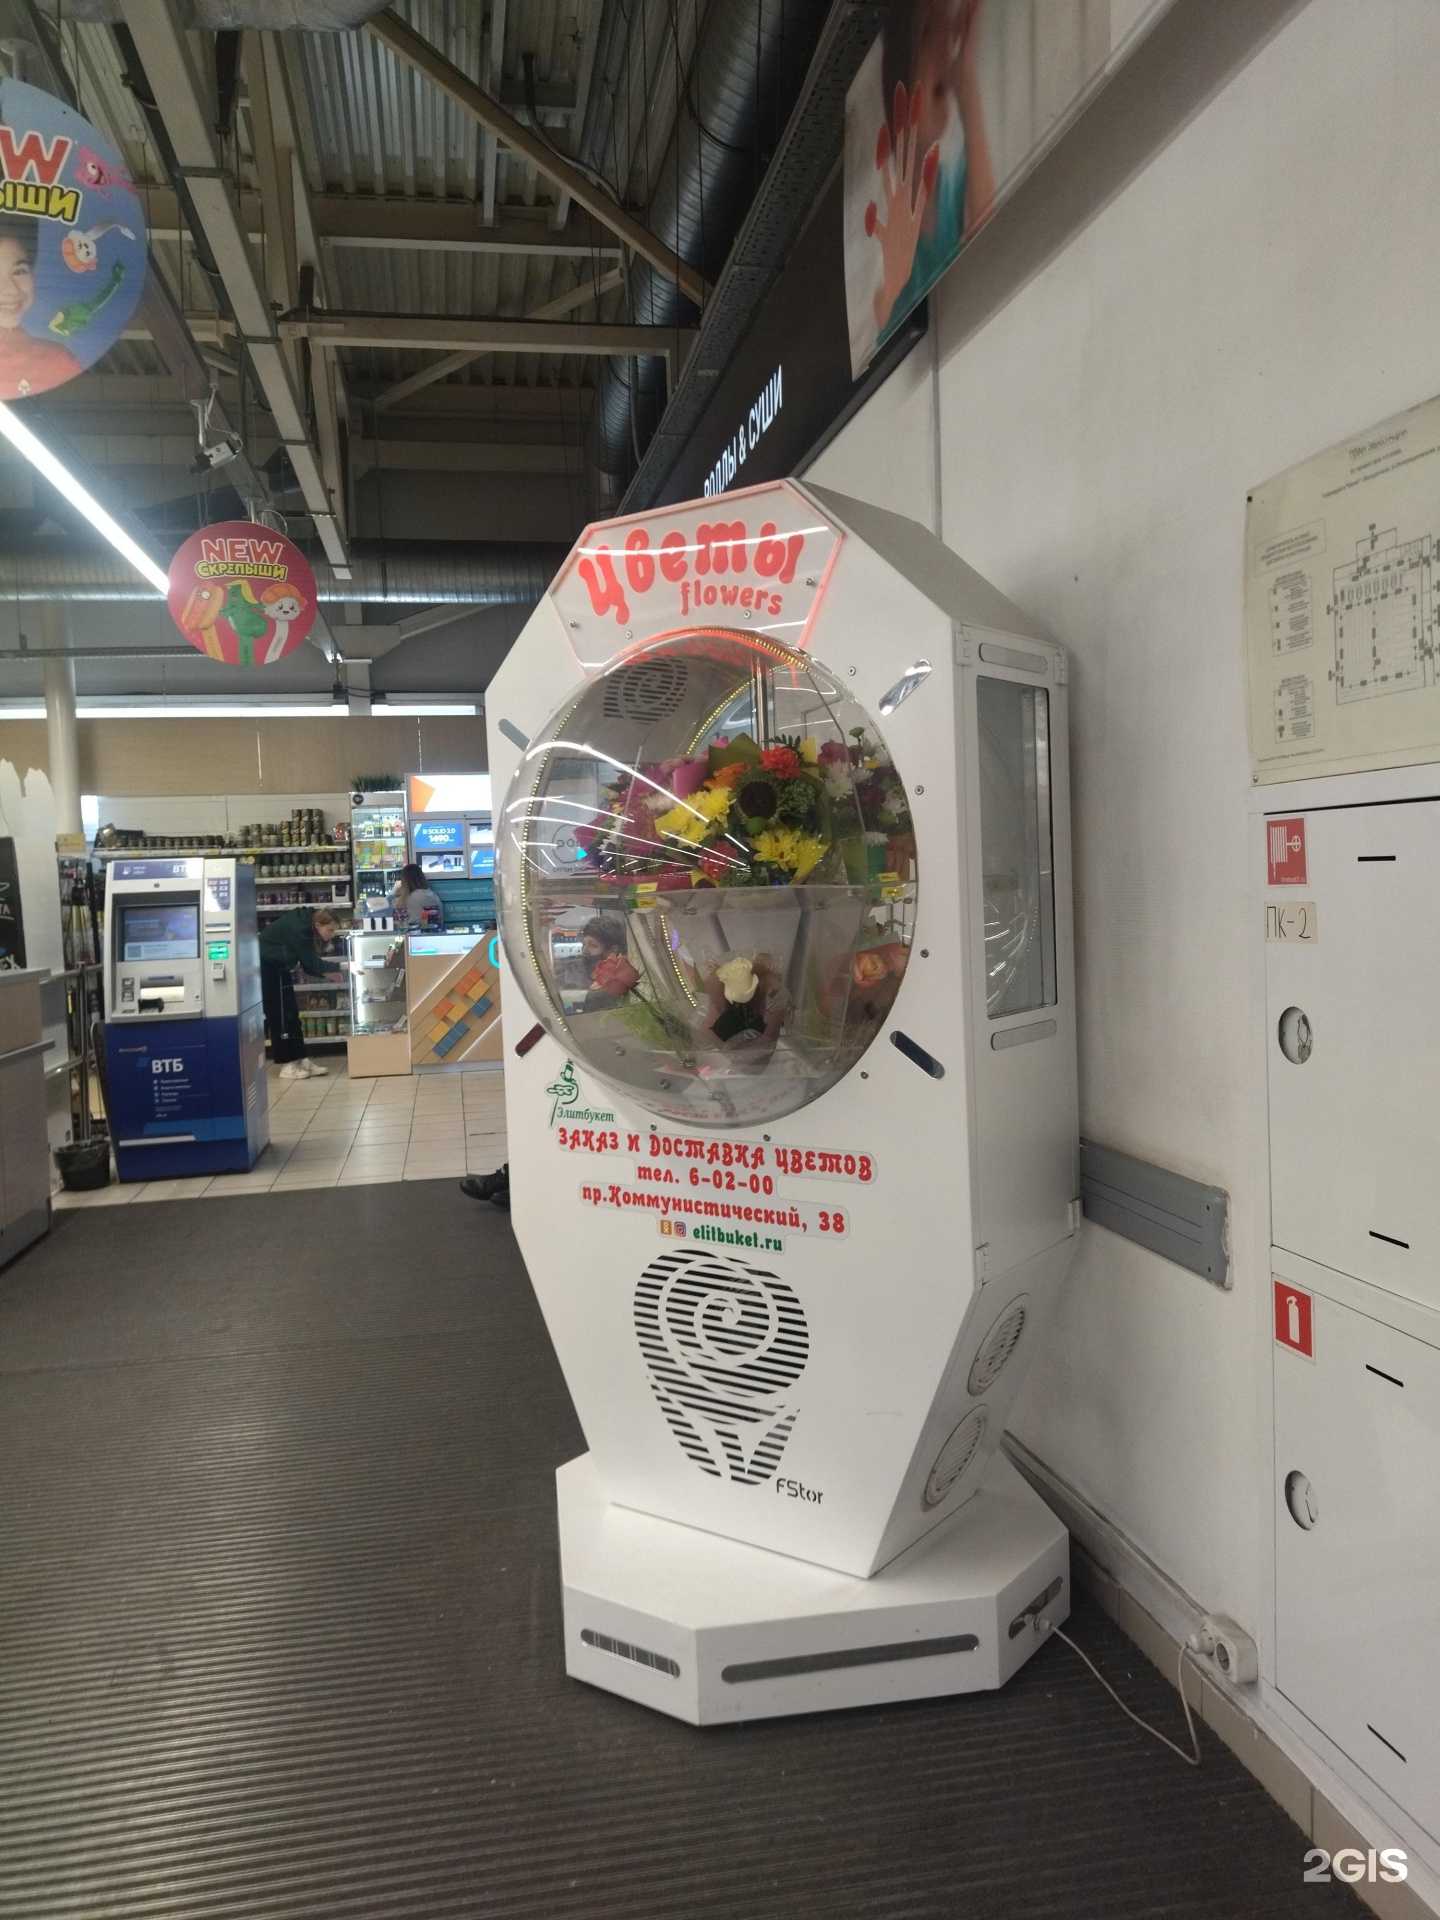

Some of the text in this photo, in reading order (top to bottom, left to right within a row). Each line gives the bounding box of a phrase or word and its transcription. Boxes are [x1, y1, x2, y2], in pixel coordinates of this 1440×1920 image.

[738, 423, 747, 465] &
[748, 363, 783, 451] СУШИ
[201, 538, 284, 564] NEW
[680, 579, 783, 616] flowers
[1266, 905, 1312, 939] ПК-2
[151, 1058, 184, 1074] ВТБ
[556, 1106, 615, 1123] Элитбукет
[558, 1126, 619, 1153] ЗАКАЗ
[627, 1133, 640, 1153] И
[774, 1147, 873, 1182] ЦВЕТОВ
[637, 1165, 774, 1196] тел. 6-02-00
[818, 1211, 846, 1233] 38
[692, 1224, 783, 1252] elitbuket.ru
